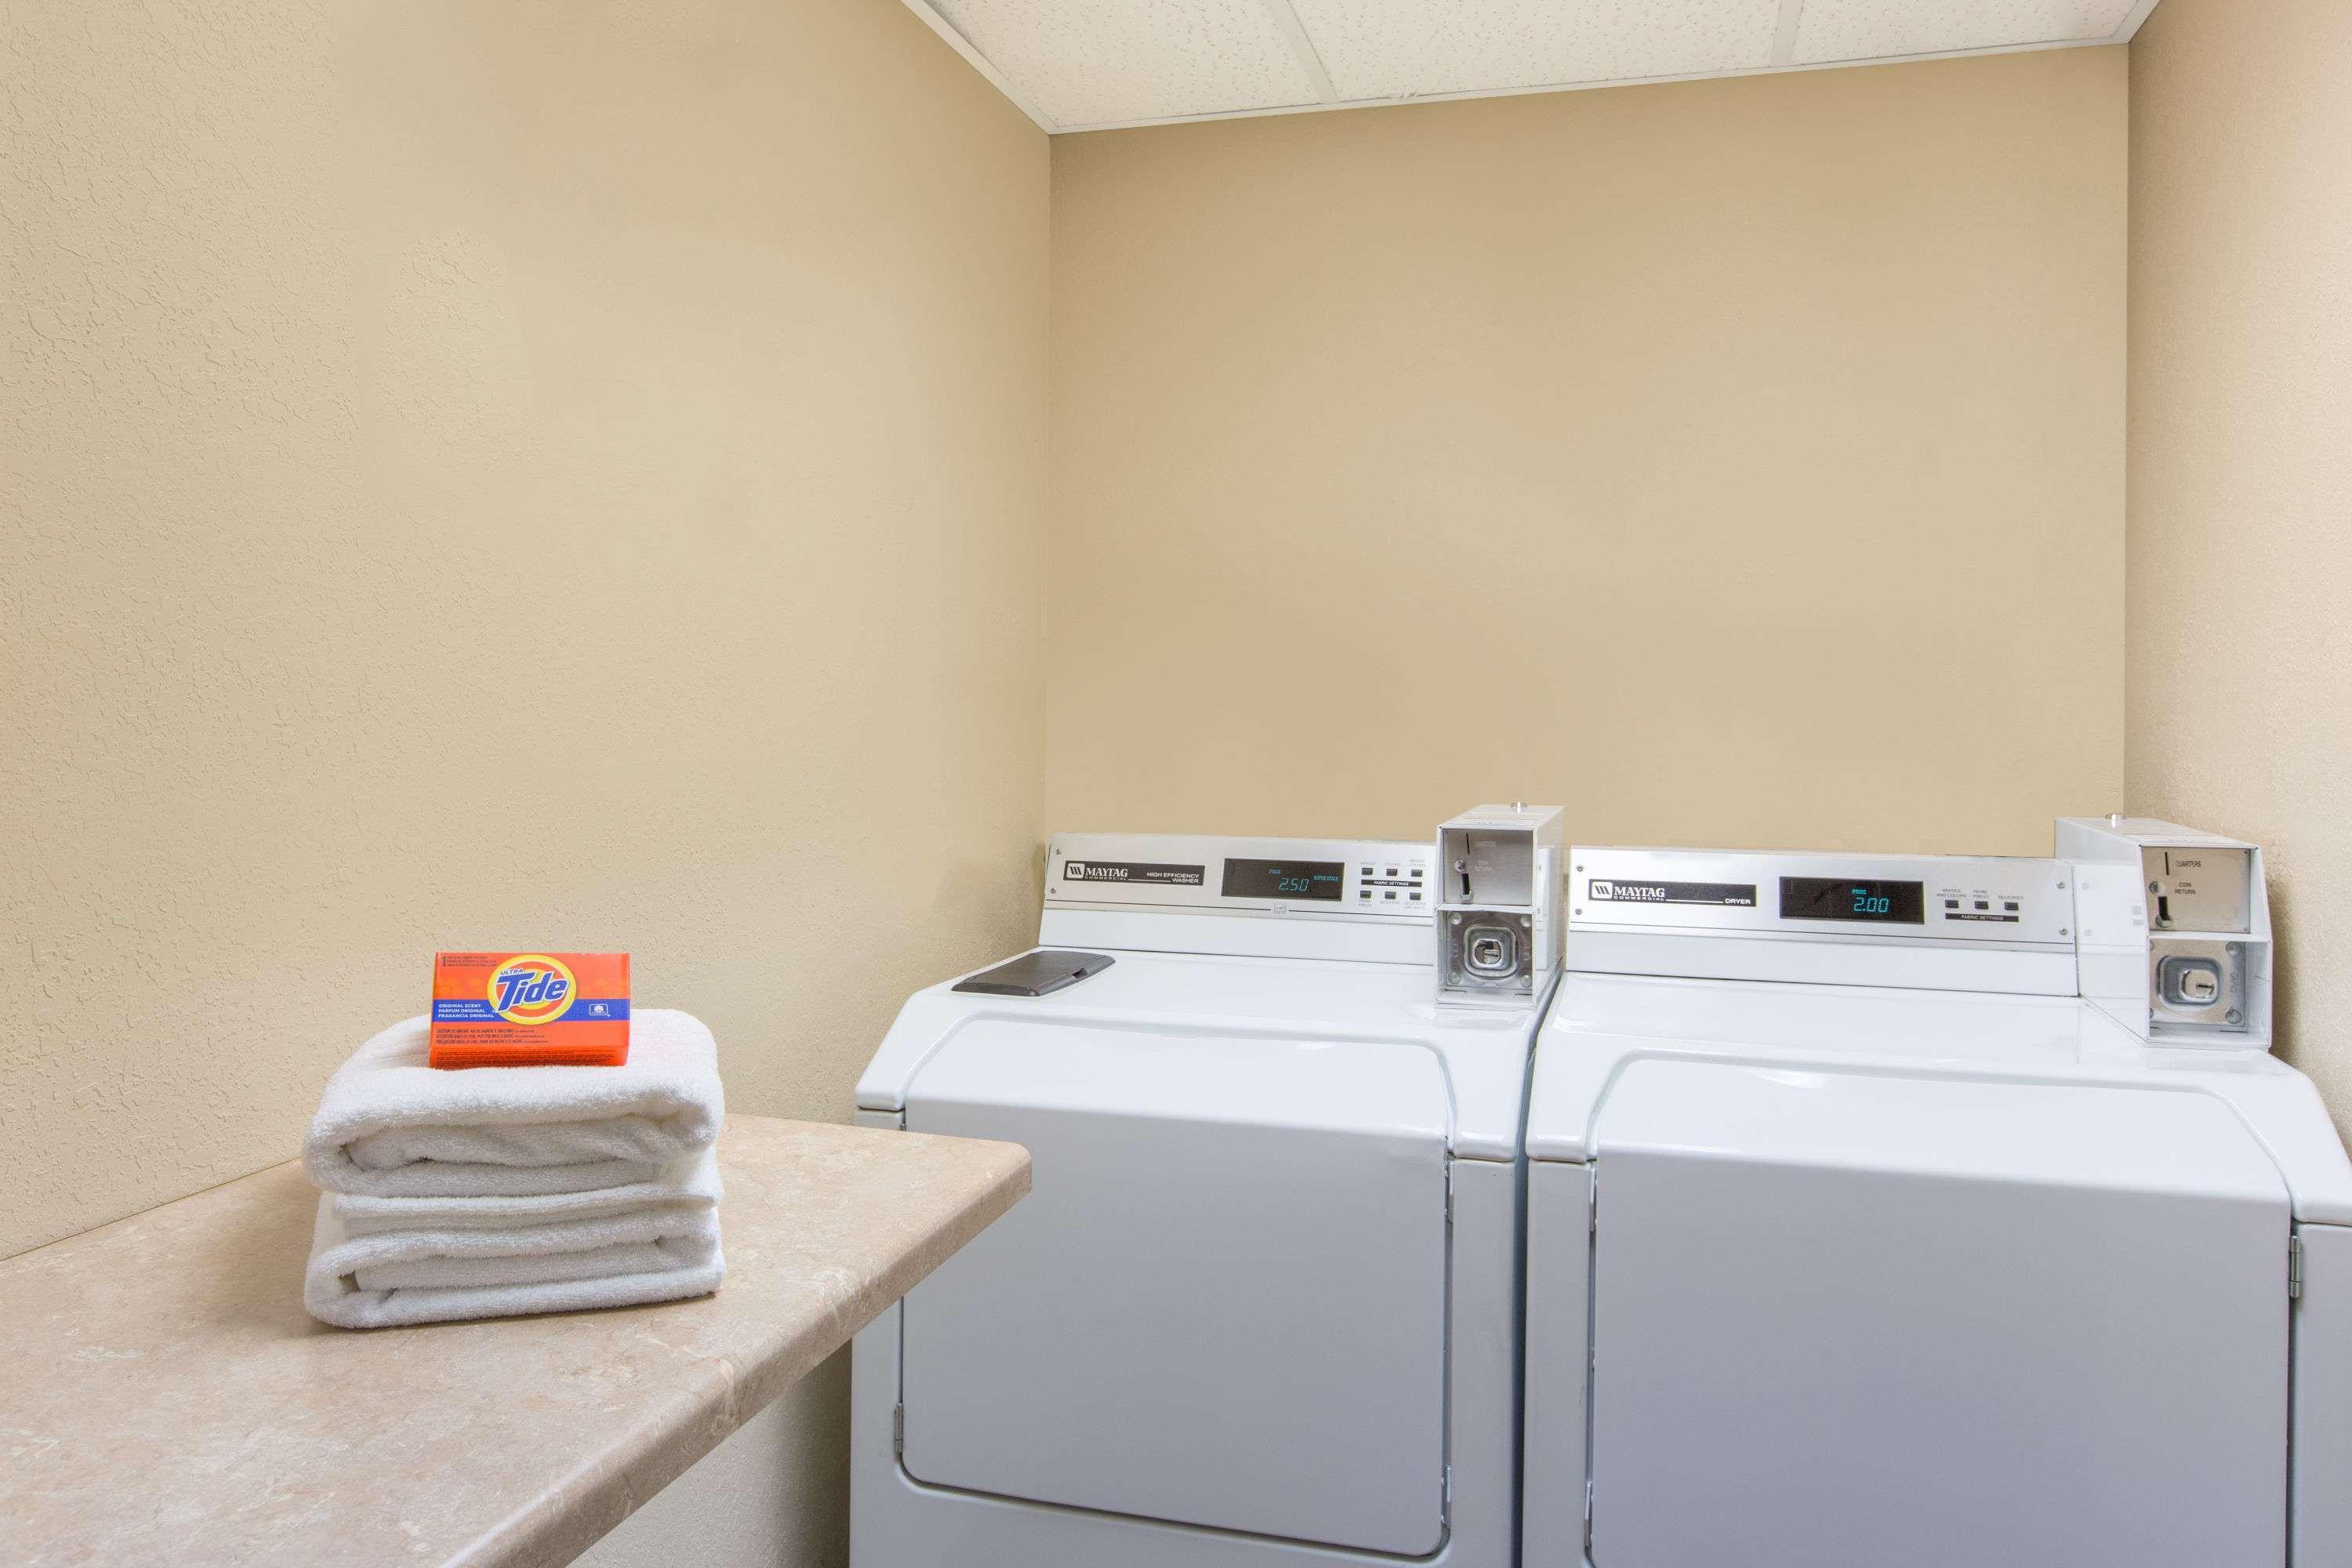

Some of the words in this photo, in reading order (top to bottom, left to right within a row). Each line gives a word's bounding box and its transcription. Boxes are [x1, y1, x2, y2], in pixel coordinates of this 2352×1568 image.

[1085, 867, 1128, 877] MAYTAG
[1279, 877, 1309, 891] 2.50
[1613, 886, 1665, 898] MAYTAG
[1853, 897, 1889, 913] 2.00
[496, 971, 568, 1012] Tide
